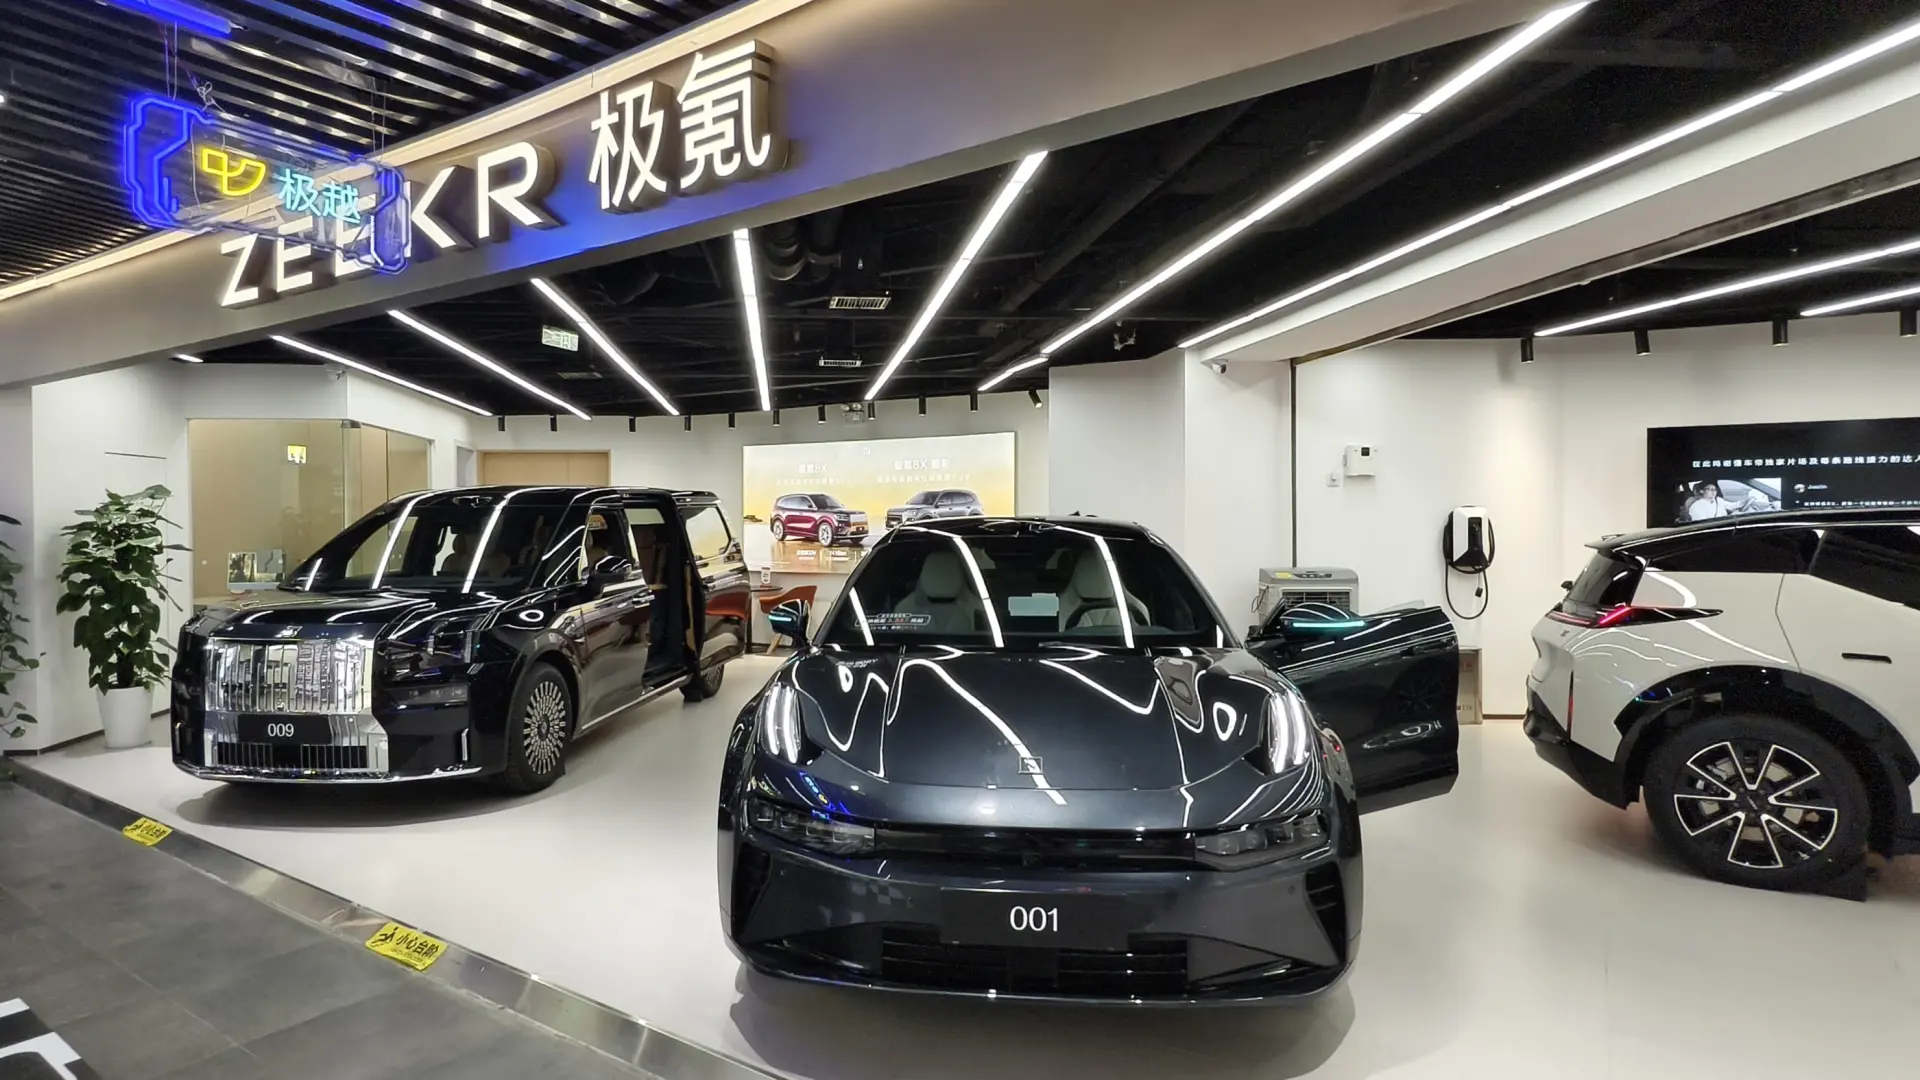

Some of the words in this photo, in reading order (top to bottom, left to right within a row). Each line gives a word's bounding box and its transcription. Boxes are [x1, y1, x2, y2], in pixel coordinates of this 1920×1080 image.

[220, 141, 547, 307] ZEEKR
[589, 40, 771, 210] 极氪
[277, 168, 361, 225] 极越
[267, 722, 295, 738] 009
[1010, 906, 1058, 932] 001
[396, 933, 440, 960] 小心台阶
